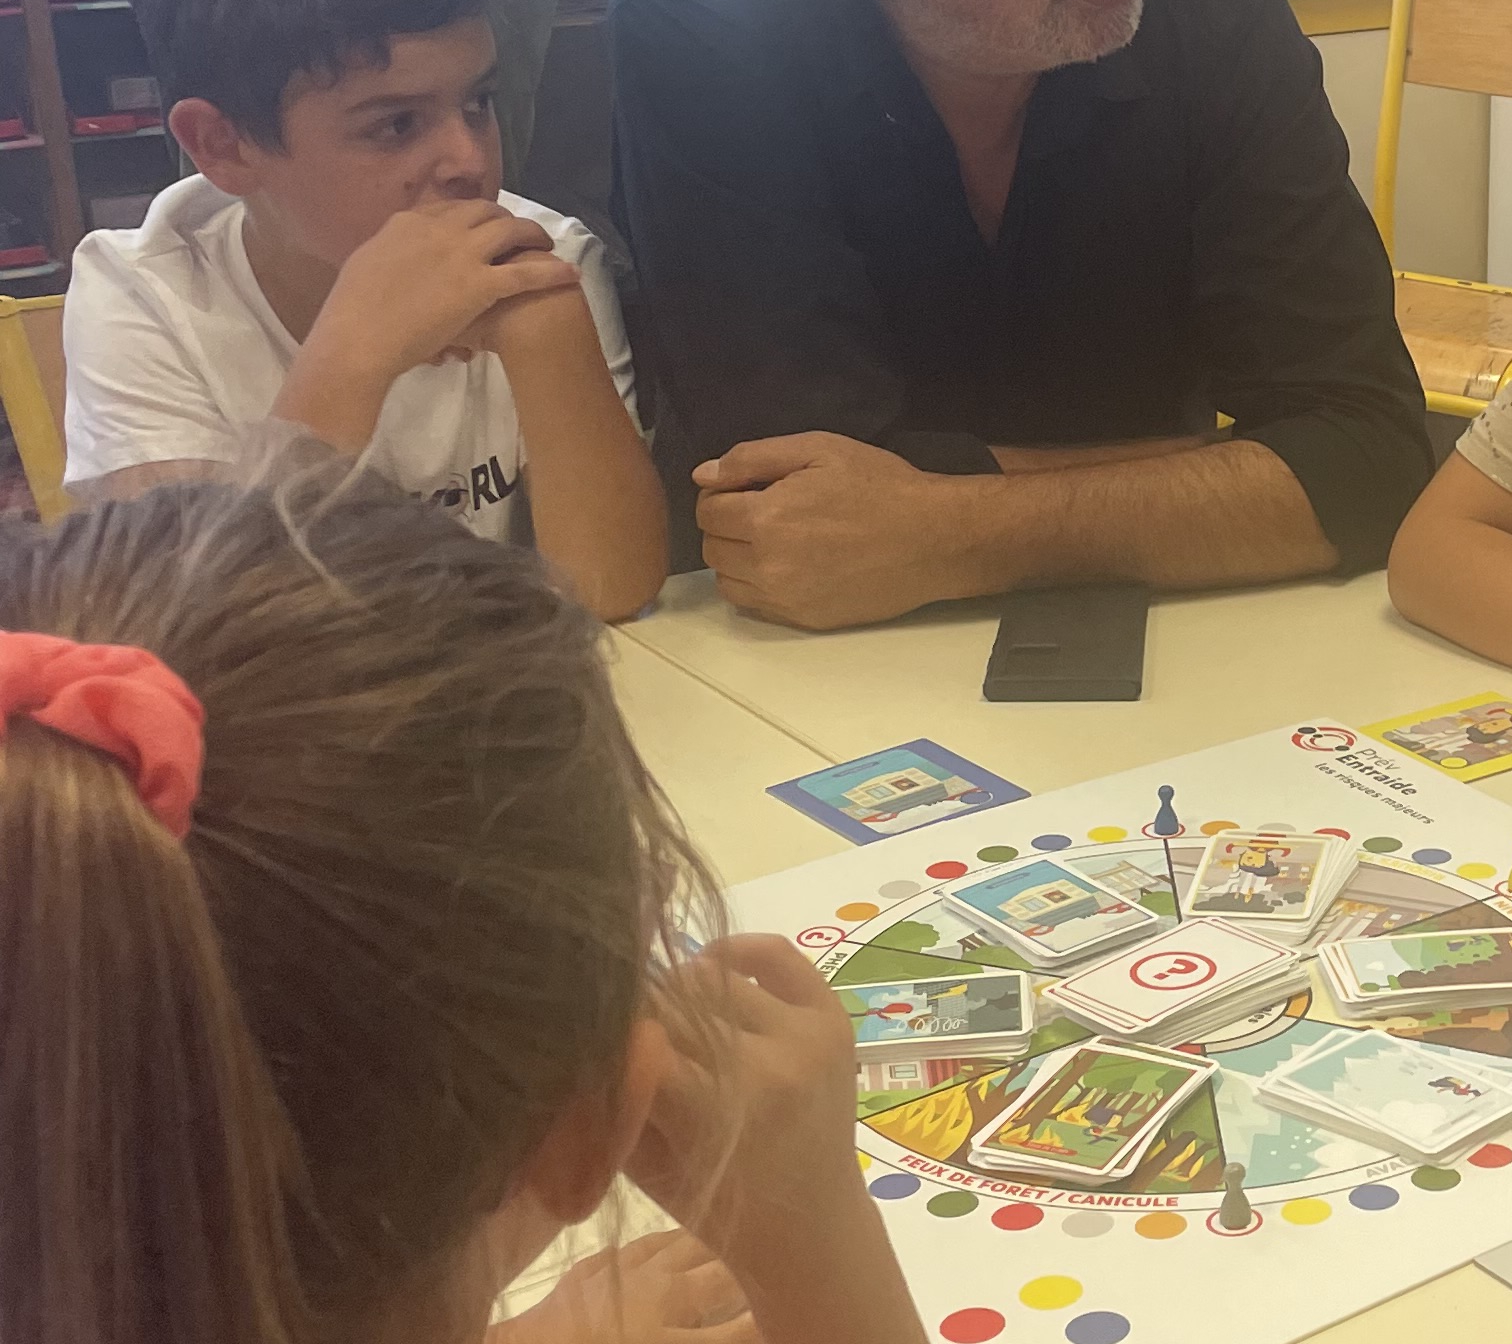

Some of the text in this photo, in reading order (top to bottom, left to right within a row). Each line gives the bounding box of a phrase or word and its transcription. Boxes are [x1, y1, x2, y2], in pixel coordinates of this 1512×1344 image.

[1335, 754, 1418, 796] Entraide
[1354, 748, 1401, 771] Prév
[1314, 762, 1435, 825] les risques majeurs
[898, 1154, 948, 1179] FEUX
[948, 1171, 975, 1188] DE
[977, 1179, 1052, 1200] FORÊT
[1067, 1193, 1180, 1208] CANICULE
